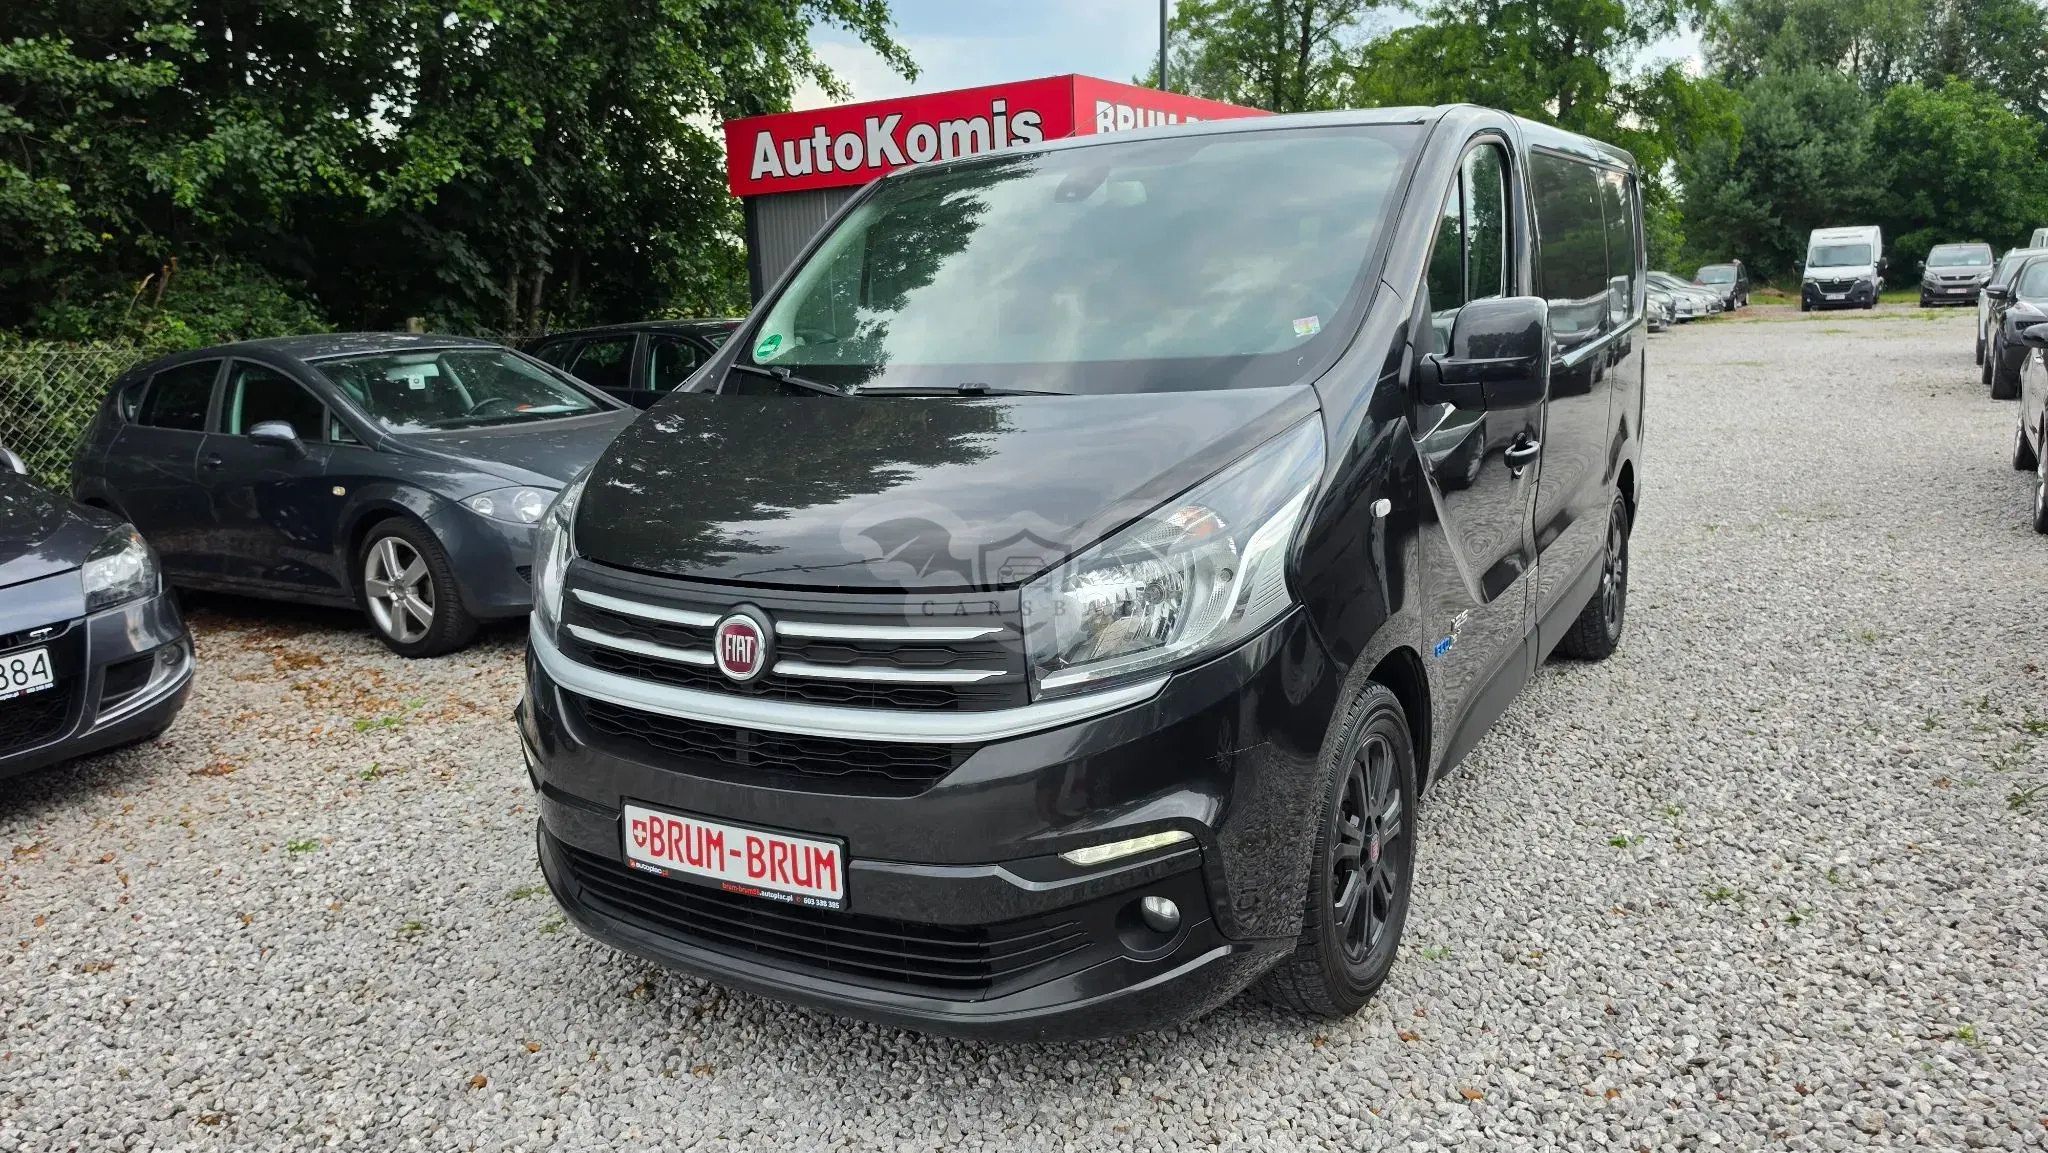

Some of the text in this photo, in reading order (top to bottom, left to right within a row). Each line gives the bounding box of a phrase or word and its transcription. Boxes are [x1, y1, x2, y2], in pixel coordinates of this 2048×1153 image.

[750, 98, 1044, 180] AutoKomis
[725, 634, 754, 664] FIAT
[649, 815, 837, 892] BRUM-BRUM
